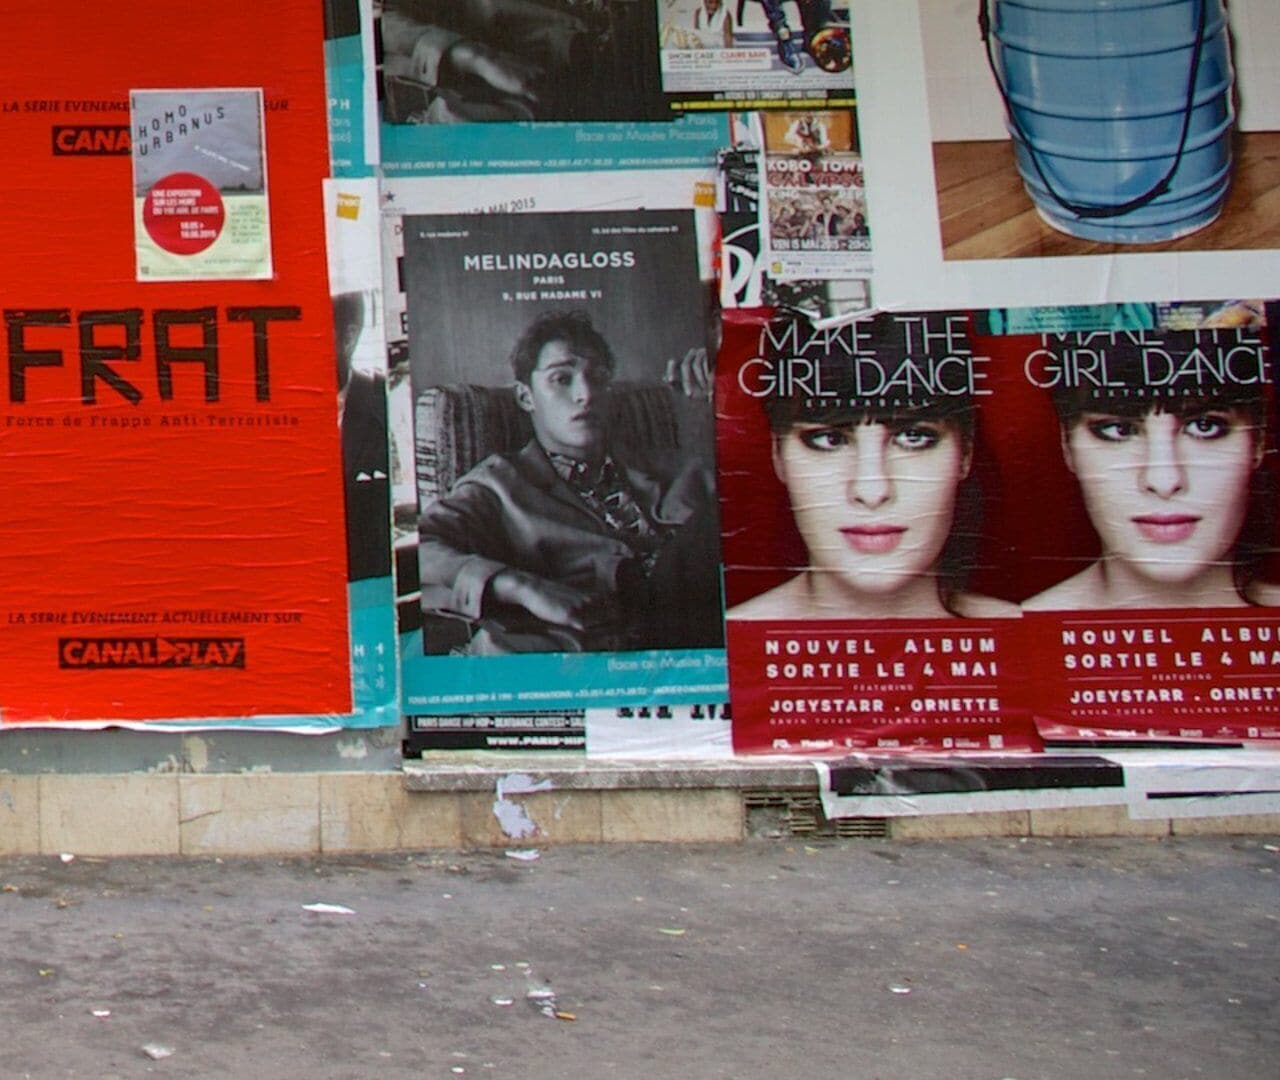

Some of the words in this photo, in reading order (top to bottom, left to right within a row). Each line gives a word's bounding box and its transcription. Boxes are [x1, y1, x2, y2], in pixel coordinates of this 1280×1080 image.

[139, 105, 186, 138] HOMO
[140, 107, 225, 155] URBANUS
[511, 197, 536, 211] 2015
[464, 251, 635, 271] MELINDAGLOSS
[533, 275, 565, 285] PARIS
[516, 291, 537, 301] RUE
[541, 290, 586, 300] MADAME
[759, 317, 876, 356] MAKE
[894, 317, 971, 355] THE
[3, 306, 302, 405] FRAT
[1024, 348, 1125, 388] GIRL
[1142, 346, 1272, 386] DANCE
[738, 358, 837, 397] GIRL
[855, 357, 993, 396] DANCE
[1062, 629, 1172, 645] NOUVEL
[1202, 627, 1280, 642] ALBU
[765, 639, 875, 655] NOUVEL
[904, 638, 995, 653] ALBUM
[1064, 653, 1158, 669] SORTIE
[1175, 652, 1203, 667] LE
[1221, 651, 1232, 666] 4
[766, 663, 859, 678] SORTIE
[877, 663, 905, 677] LE
[923, 663, 934, 677] 4
[951, 662, 997, 676] MAI
[1152, 673, 1212, 681] FEATURING
[853, 684, 914, 692] FEATURING
[1070, 688, 1183, 704] JOEYSTARR
[770, 699, 883, 713] JOEYSTARR
[911, 698, 1000, 712] ORNETTE
